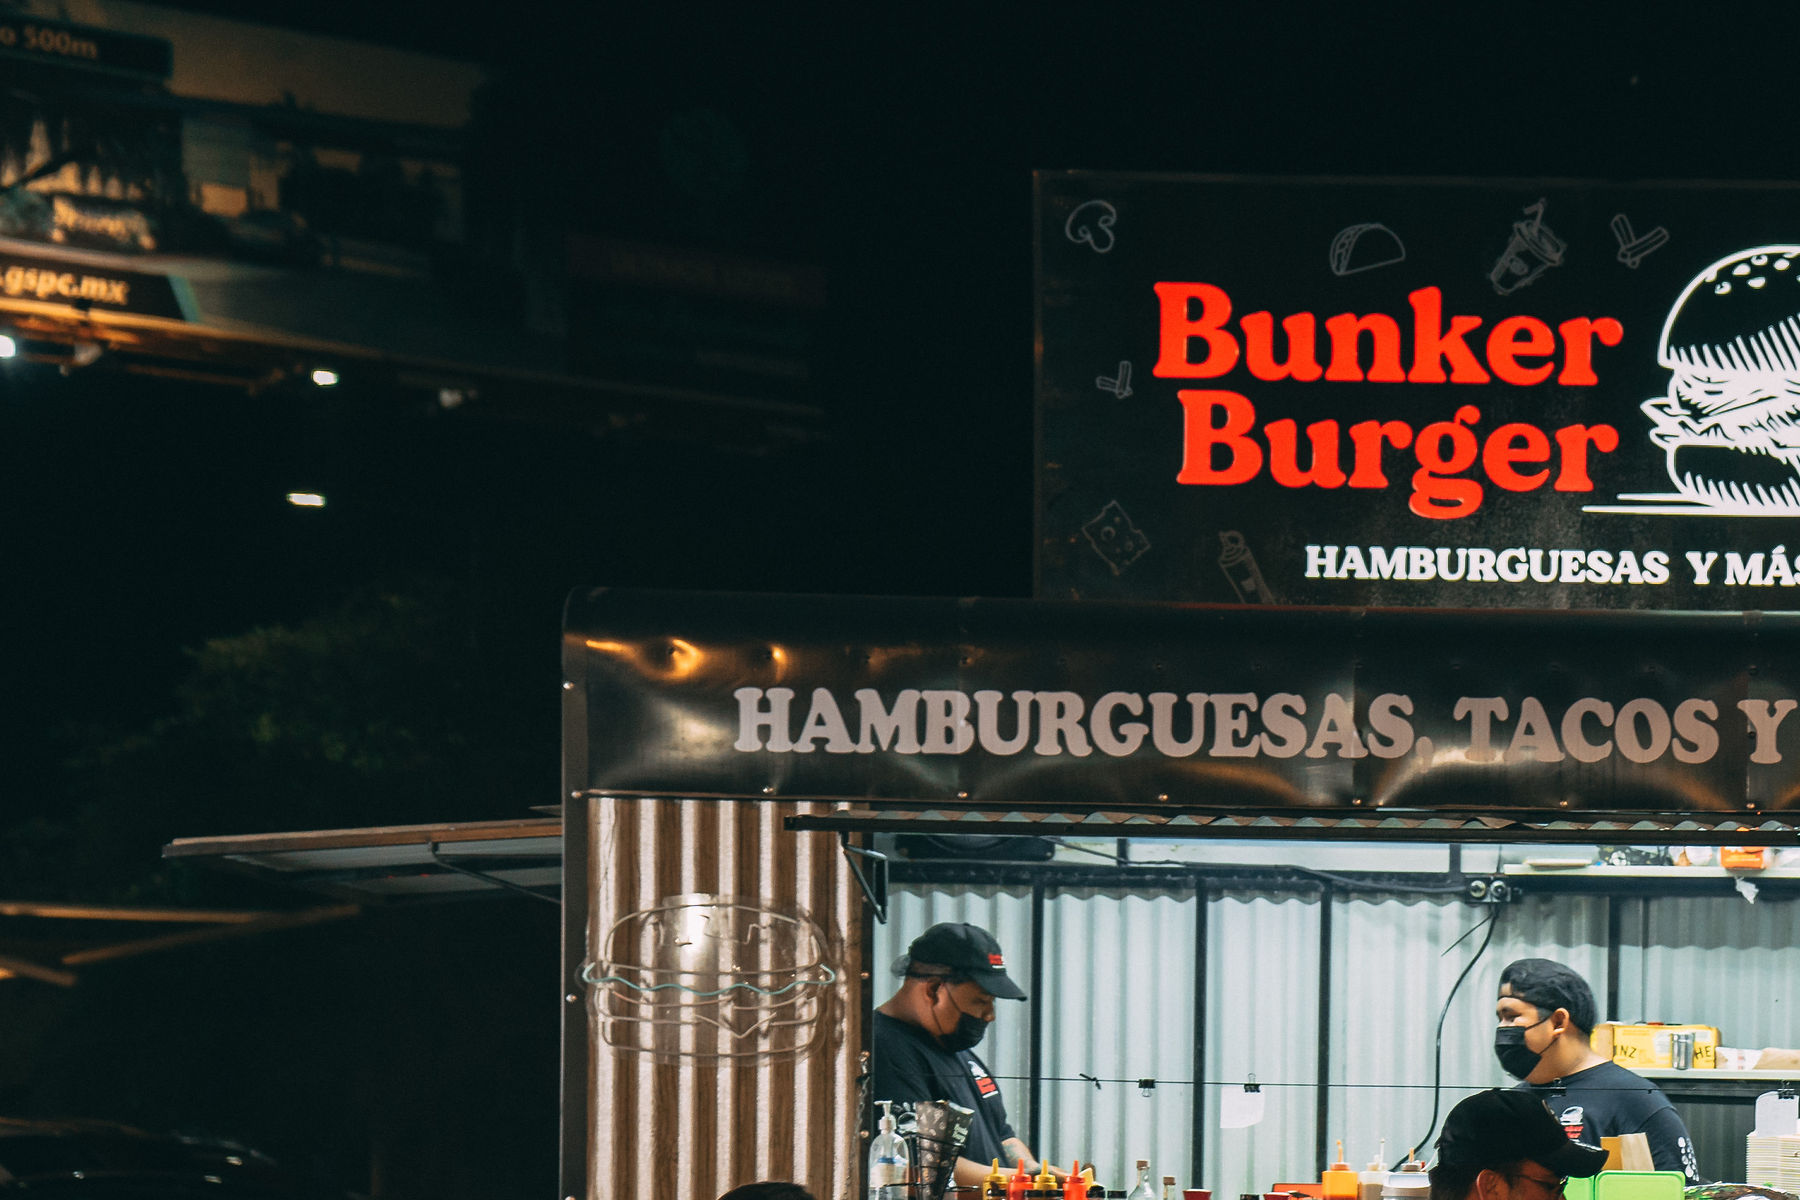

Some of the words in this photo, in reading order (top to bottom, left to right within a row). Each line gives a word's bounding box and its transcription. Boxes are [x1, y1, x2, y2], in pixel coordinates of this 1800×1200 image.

[24, 24, 97, 60] 500m
[1153, 281, 1624, 386] Bunker
[1177, 389, 1619, 520] Burger
[1305, 545, 1670, 584] HAMBURGUESAS
[1686, 551, 1718, 585] Y
[733, 686, 1433, 774] HAMBURGUESAS,
[1452, 695, 1720, 765] TACOS
[1737, 699, 1798, 765] Y
